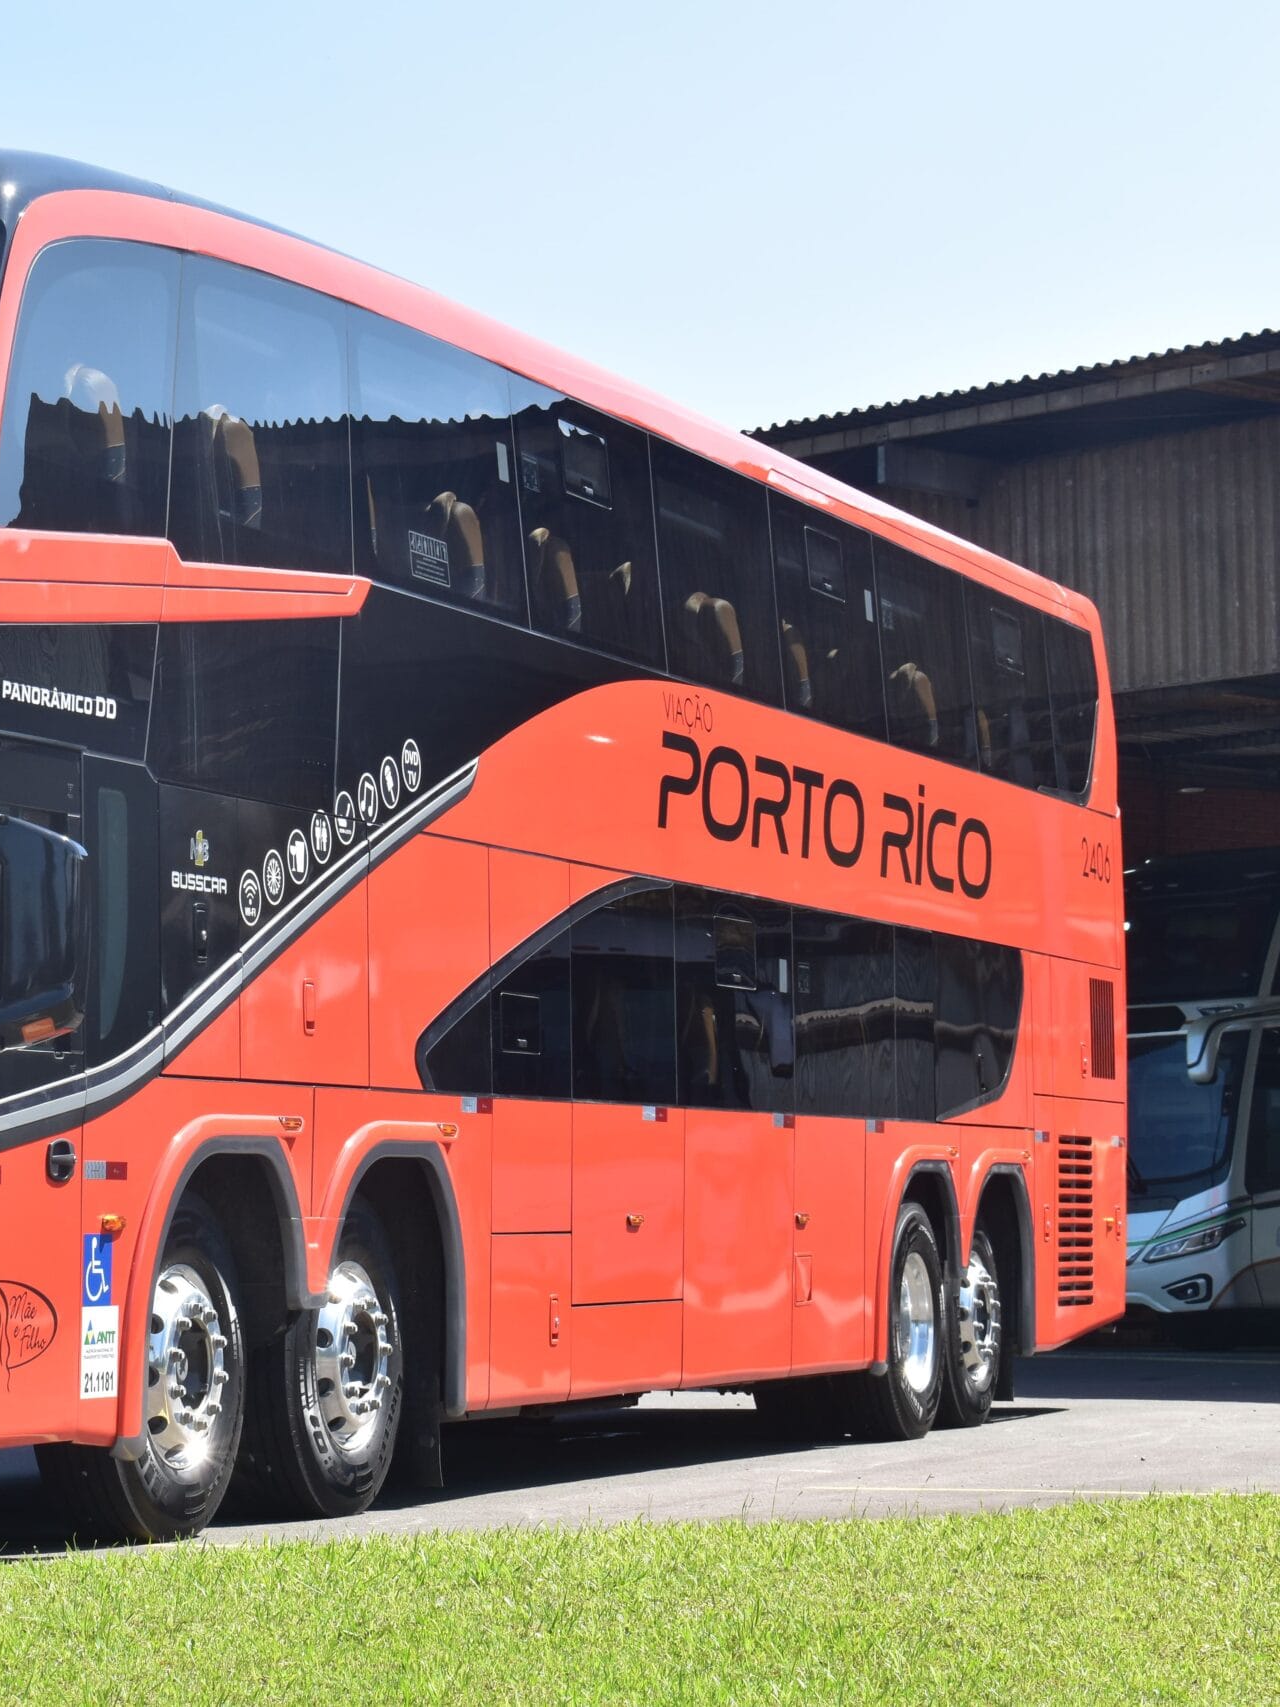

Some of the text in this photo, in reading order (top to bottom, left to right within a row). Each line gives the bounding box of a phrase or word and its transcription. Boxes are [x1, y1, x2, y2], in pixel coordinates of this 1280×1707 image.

[2, 680, 117, 720] PANORÂMICO DD
[662, 691, 714, 734] VIAÇÃO
[404, 750, 418, 766] DVD
[407, 770, 417, 786] TV
[657, 730, 865, 868] PORTO
[1081, 837, 1111, 884] 2406
[171, 870, 227, 895] BUSSCAR
[10, 1291, 37, 1322] Mãe
[13, 1324, 47, 1358] e Filho
[96, 1331, 116, 1344] ANTT
[84, 1371, 114, 1393] 21.1181
